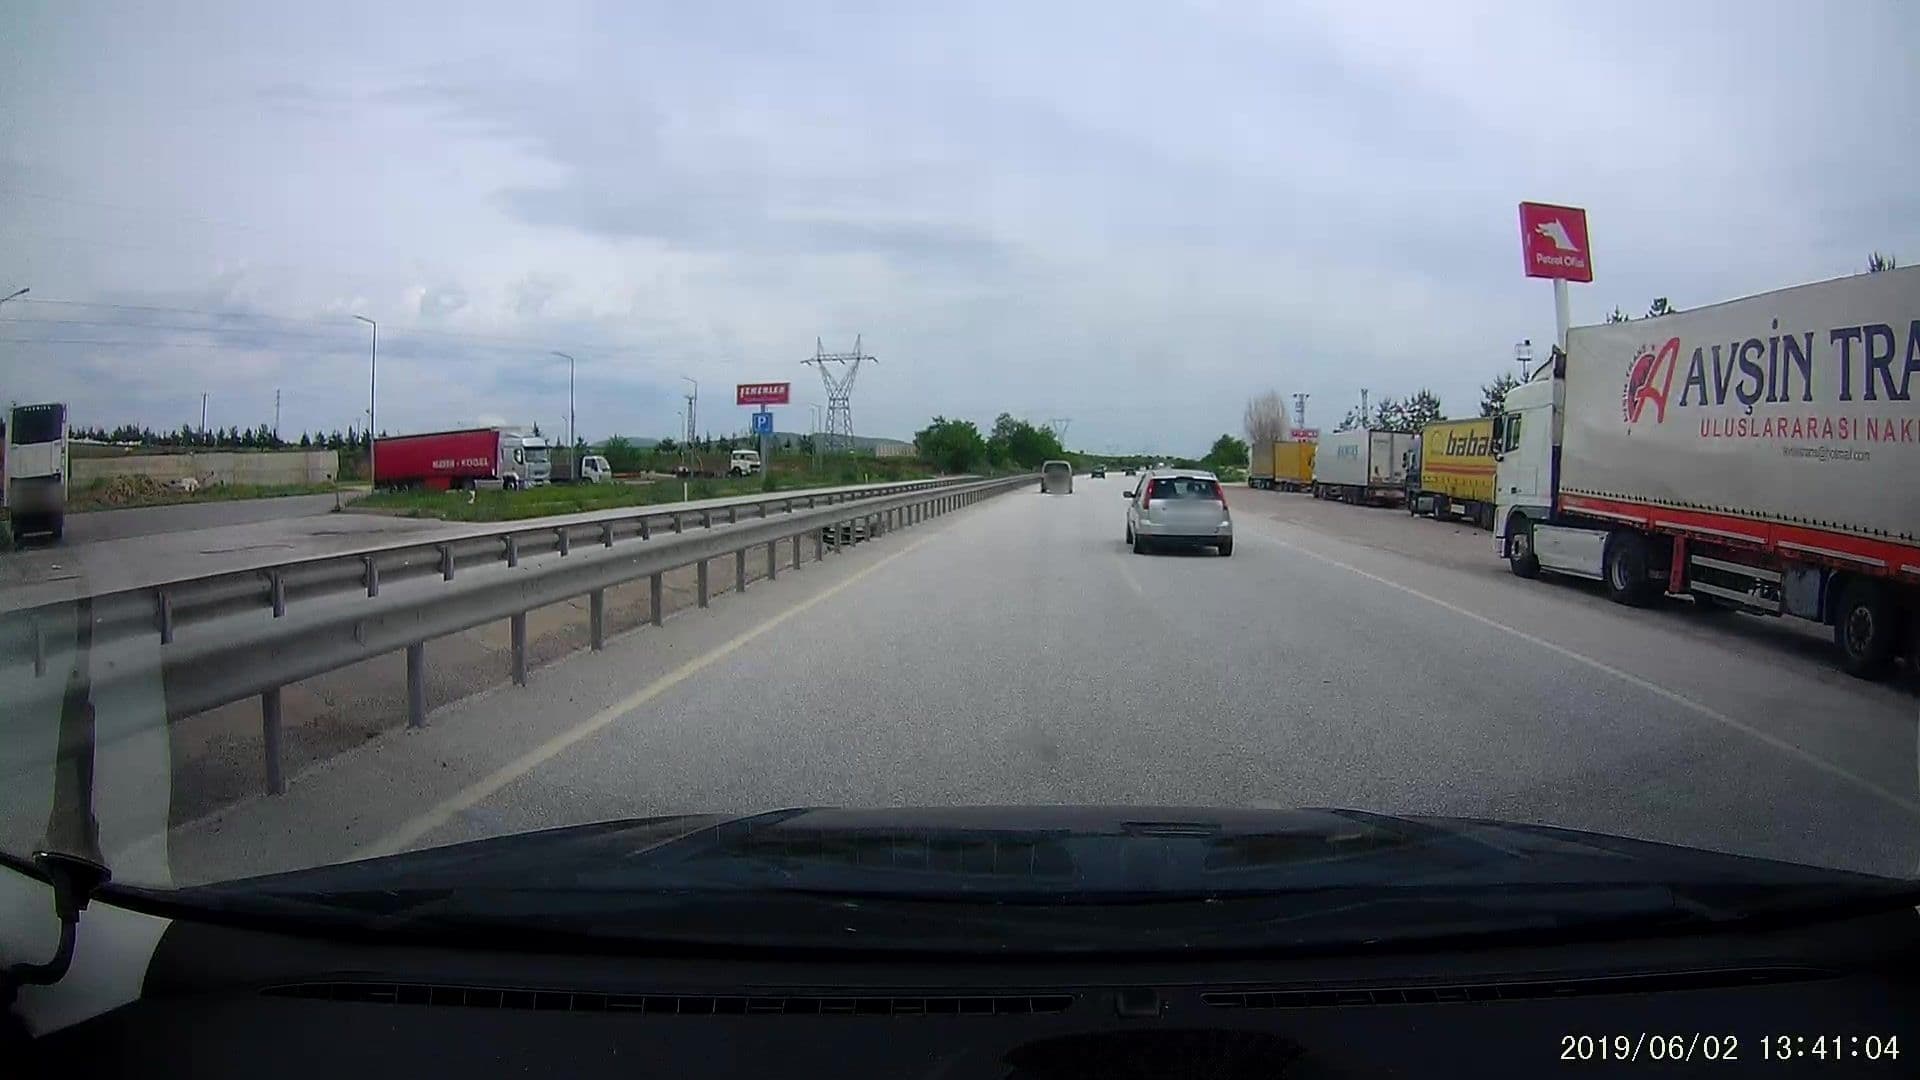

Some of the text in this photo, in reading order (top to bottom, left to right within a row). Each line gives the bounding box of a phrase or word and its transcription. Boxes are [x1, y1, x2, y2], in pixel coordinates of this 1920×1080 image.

[1536, 253, 1562, 266] Petrol
[1679, 318, 1814, 415] AVŞİN
[757, 416, 767, 428] P
[1700, 417, 1920, 443] ULUSLARARASI NAK
[1445, 428, 1491, 457] baba
